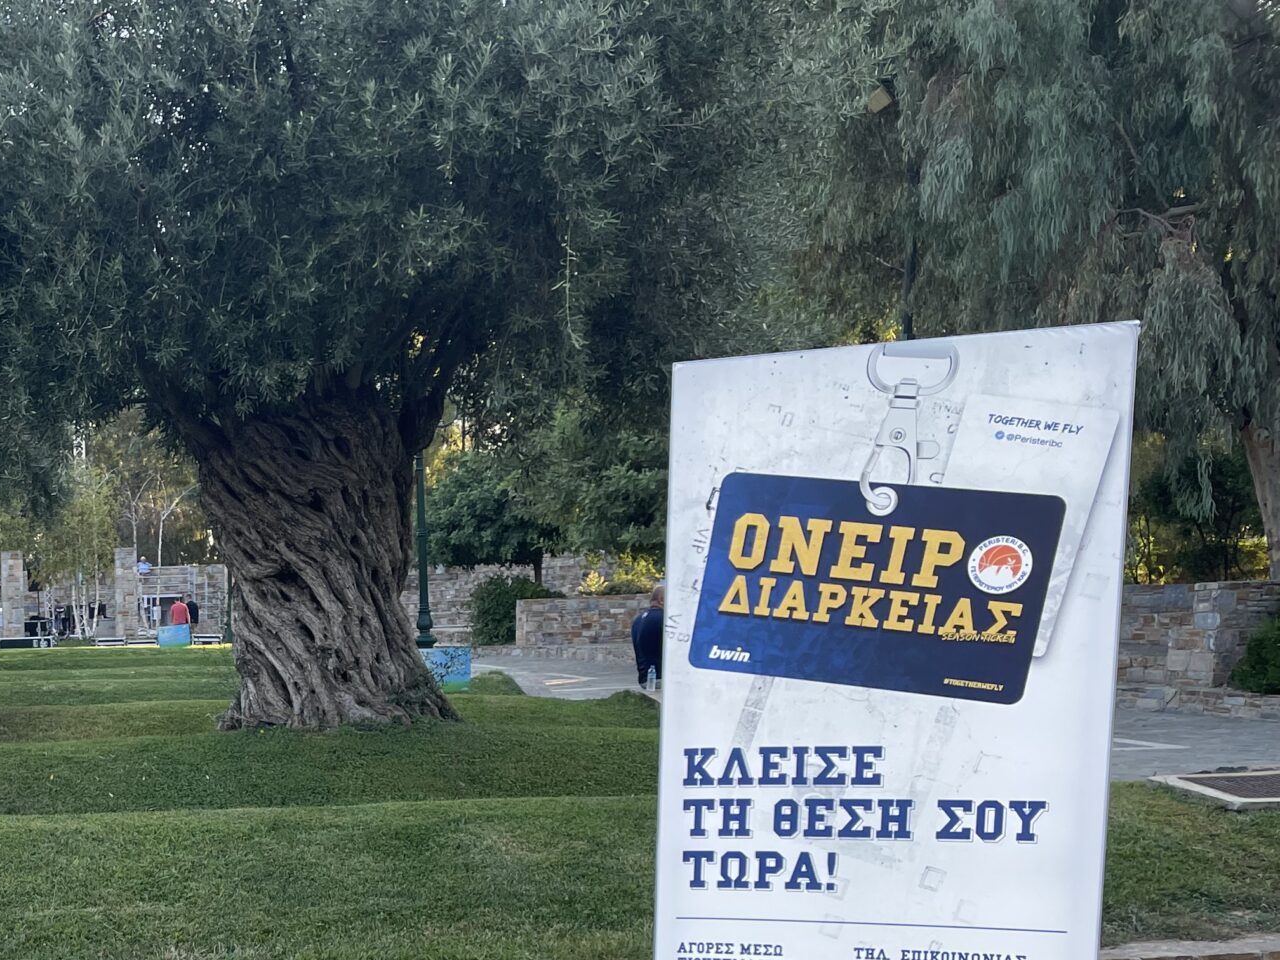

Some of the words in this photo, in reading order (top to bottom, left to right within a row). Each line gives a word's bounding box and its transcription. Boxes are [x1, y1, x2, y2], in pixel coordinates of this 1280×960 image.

[987, 413, 1041, 430] TOGETHER
[1044, 421, 1060, 432] WE
[1062, 423, 1084, 435] FLY
[1006, 433, 1063, 448] @Peristeribc
[728, 512, 966, 589] ΟΝΕΙΡ
[718, 575, 1023, 643] ΔΙΑΡΚΕΙΑΣ
[941, 631, 980, 642] SEASON
[981, 633, 1015, 643] TICKET
[708, 645, 749, 662] bwin
[683, 745, 886, 788] ΚΛΕΙΣΕ
[683, 797, 753, 839] ΤΗ
[773, 797, 915, 841] ΘΕΣΗ
[935, 799, 1049, 844] ΣΟΥ
[682, 849, 839, 893] ΤΩΡΑ!
[677, 941, 735, 956] ΑΓΟΡΕΣ
[739, 942, 783, 957] ΜΕΣΩ
